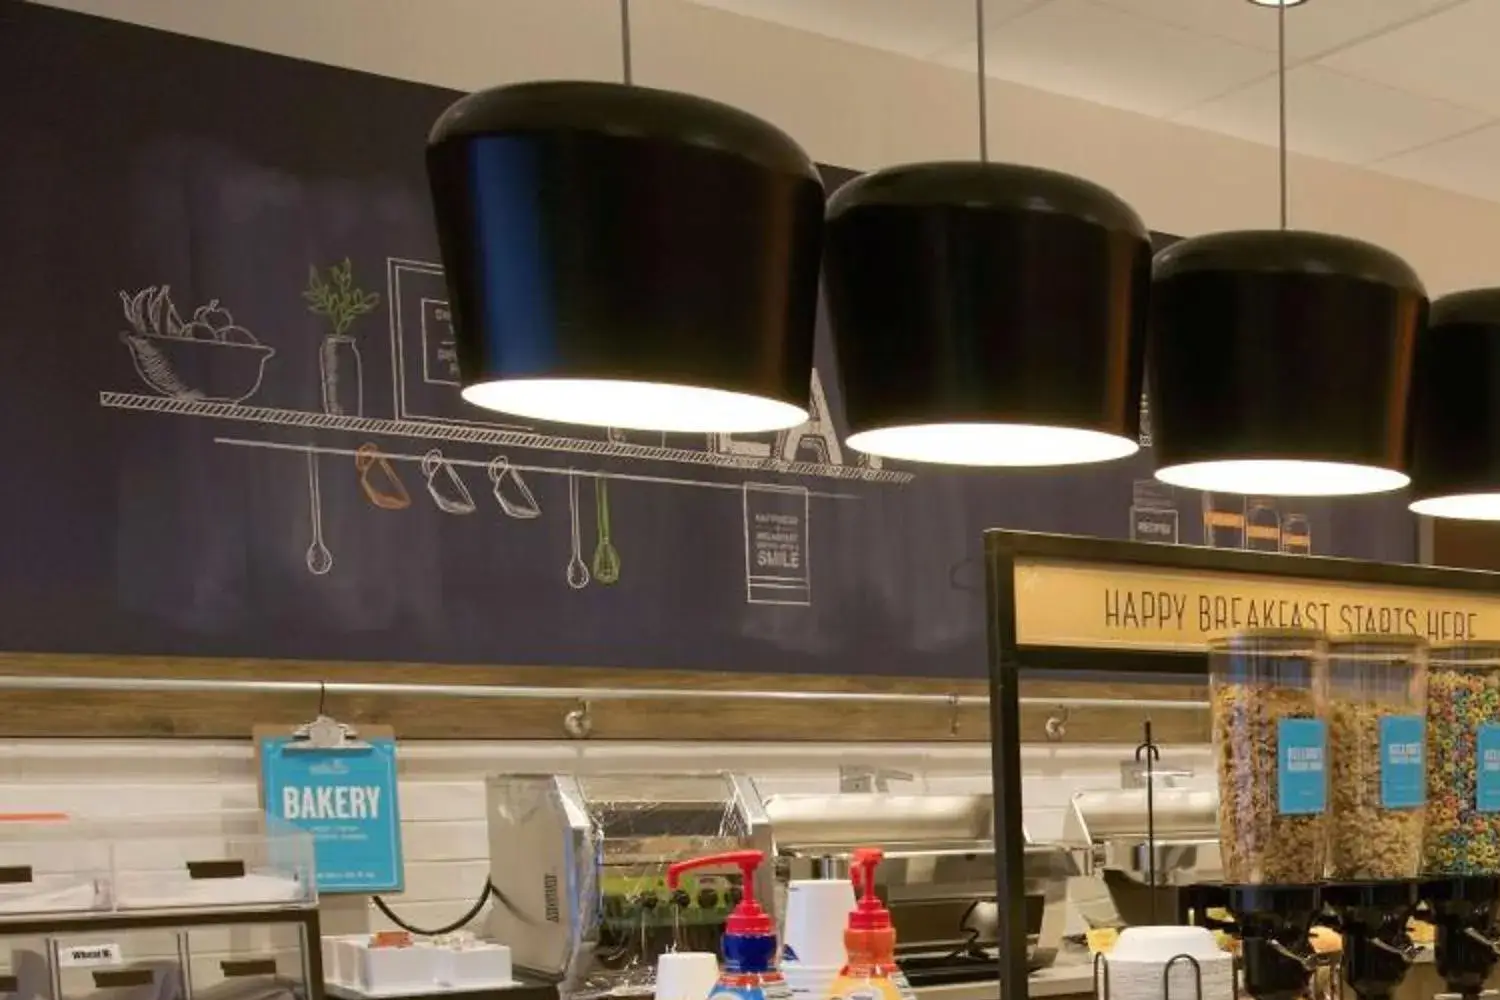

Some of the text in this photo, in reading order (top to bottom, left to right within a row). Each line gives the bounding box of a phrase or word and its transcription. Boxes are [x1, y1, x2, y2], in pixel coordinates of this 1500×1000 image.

[757, 549, 800, 568] SMILE
[1104, 588, 1186, 630] HAPPY
[1199, 594, 1330, 633] BREAKFAST
[283, 785, 381, 819] BAKERY
